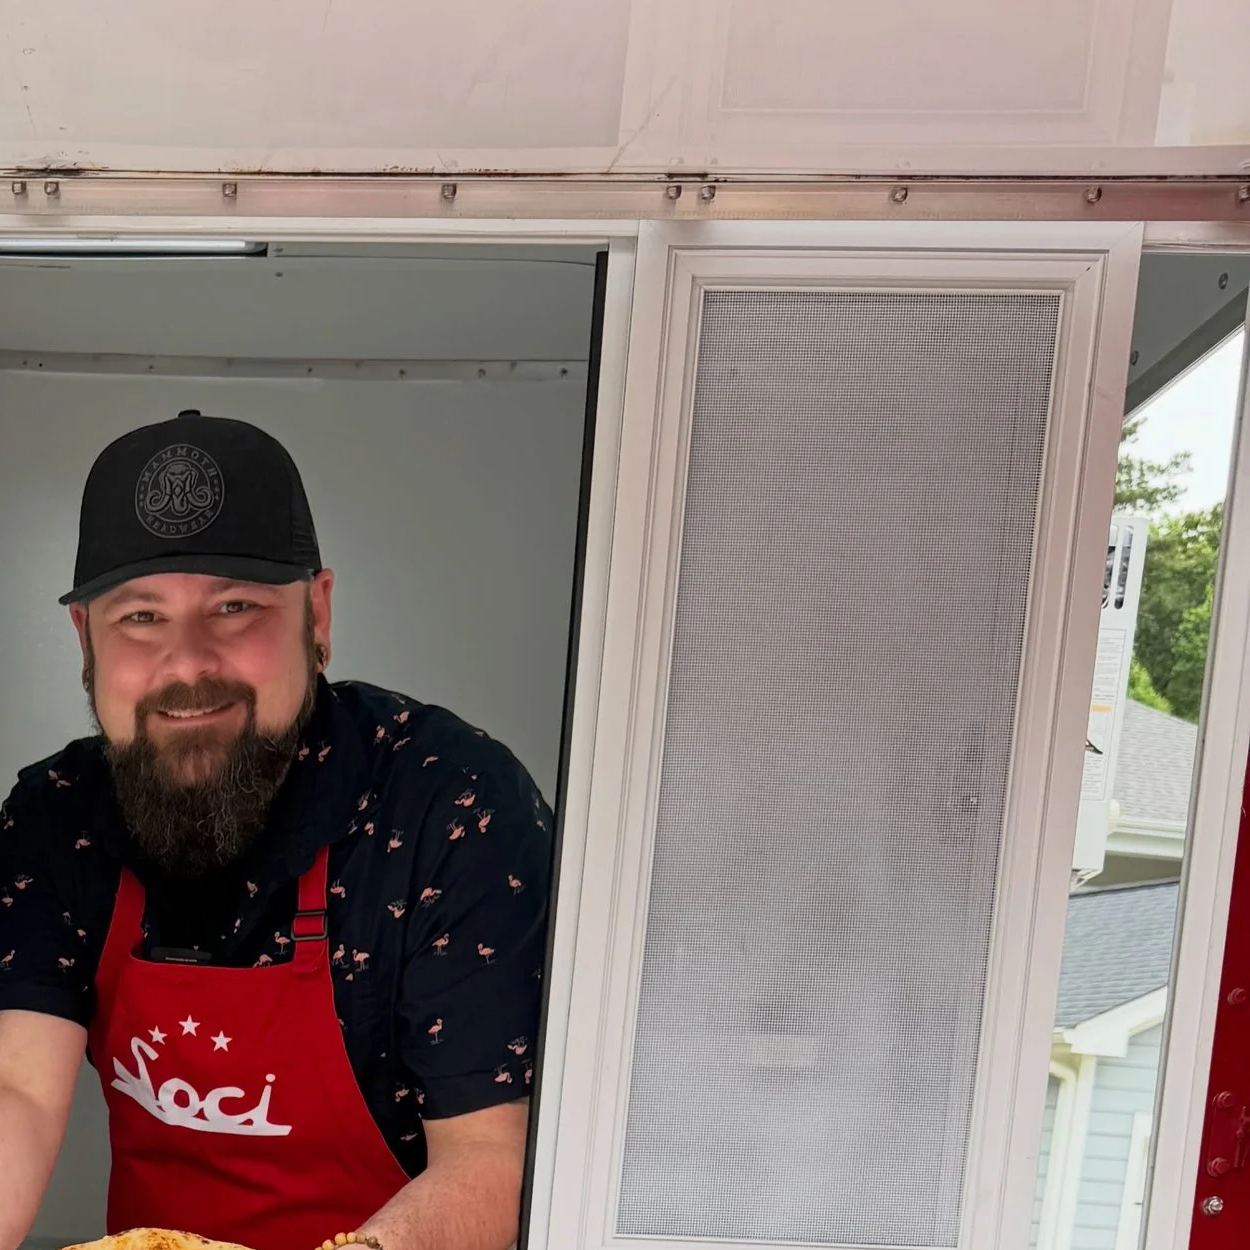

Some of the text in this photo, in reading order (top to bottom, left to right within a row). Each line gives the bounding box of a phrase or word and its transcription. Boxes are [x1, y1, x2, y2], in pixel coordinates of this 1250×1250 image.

[142, 447, 218, 482] MAMMOTH
[146, 510, 214, 534] HEADWEAR
[110, 1036, 292, 1136] Soci
